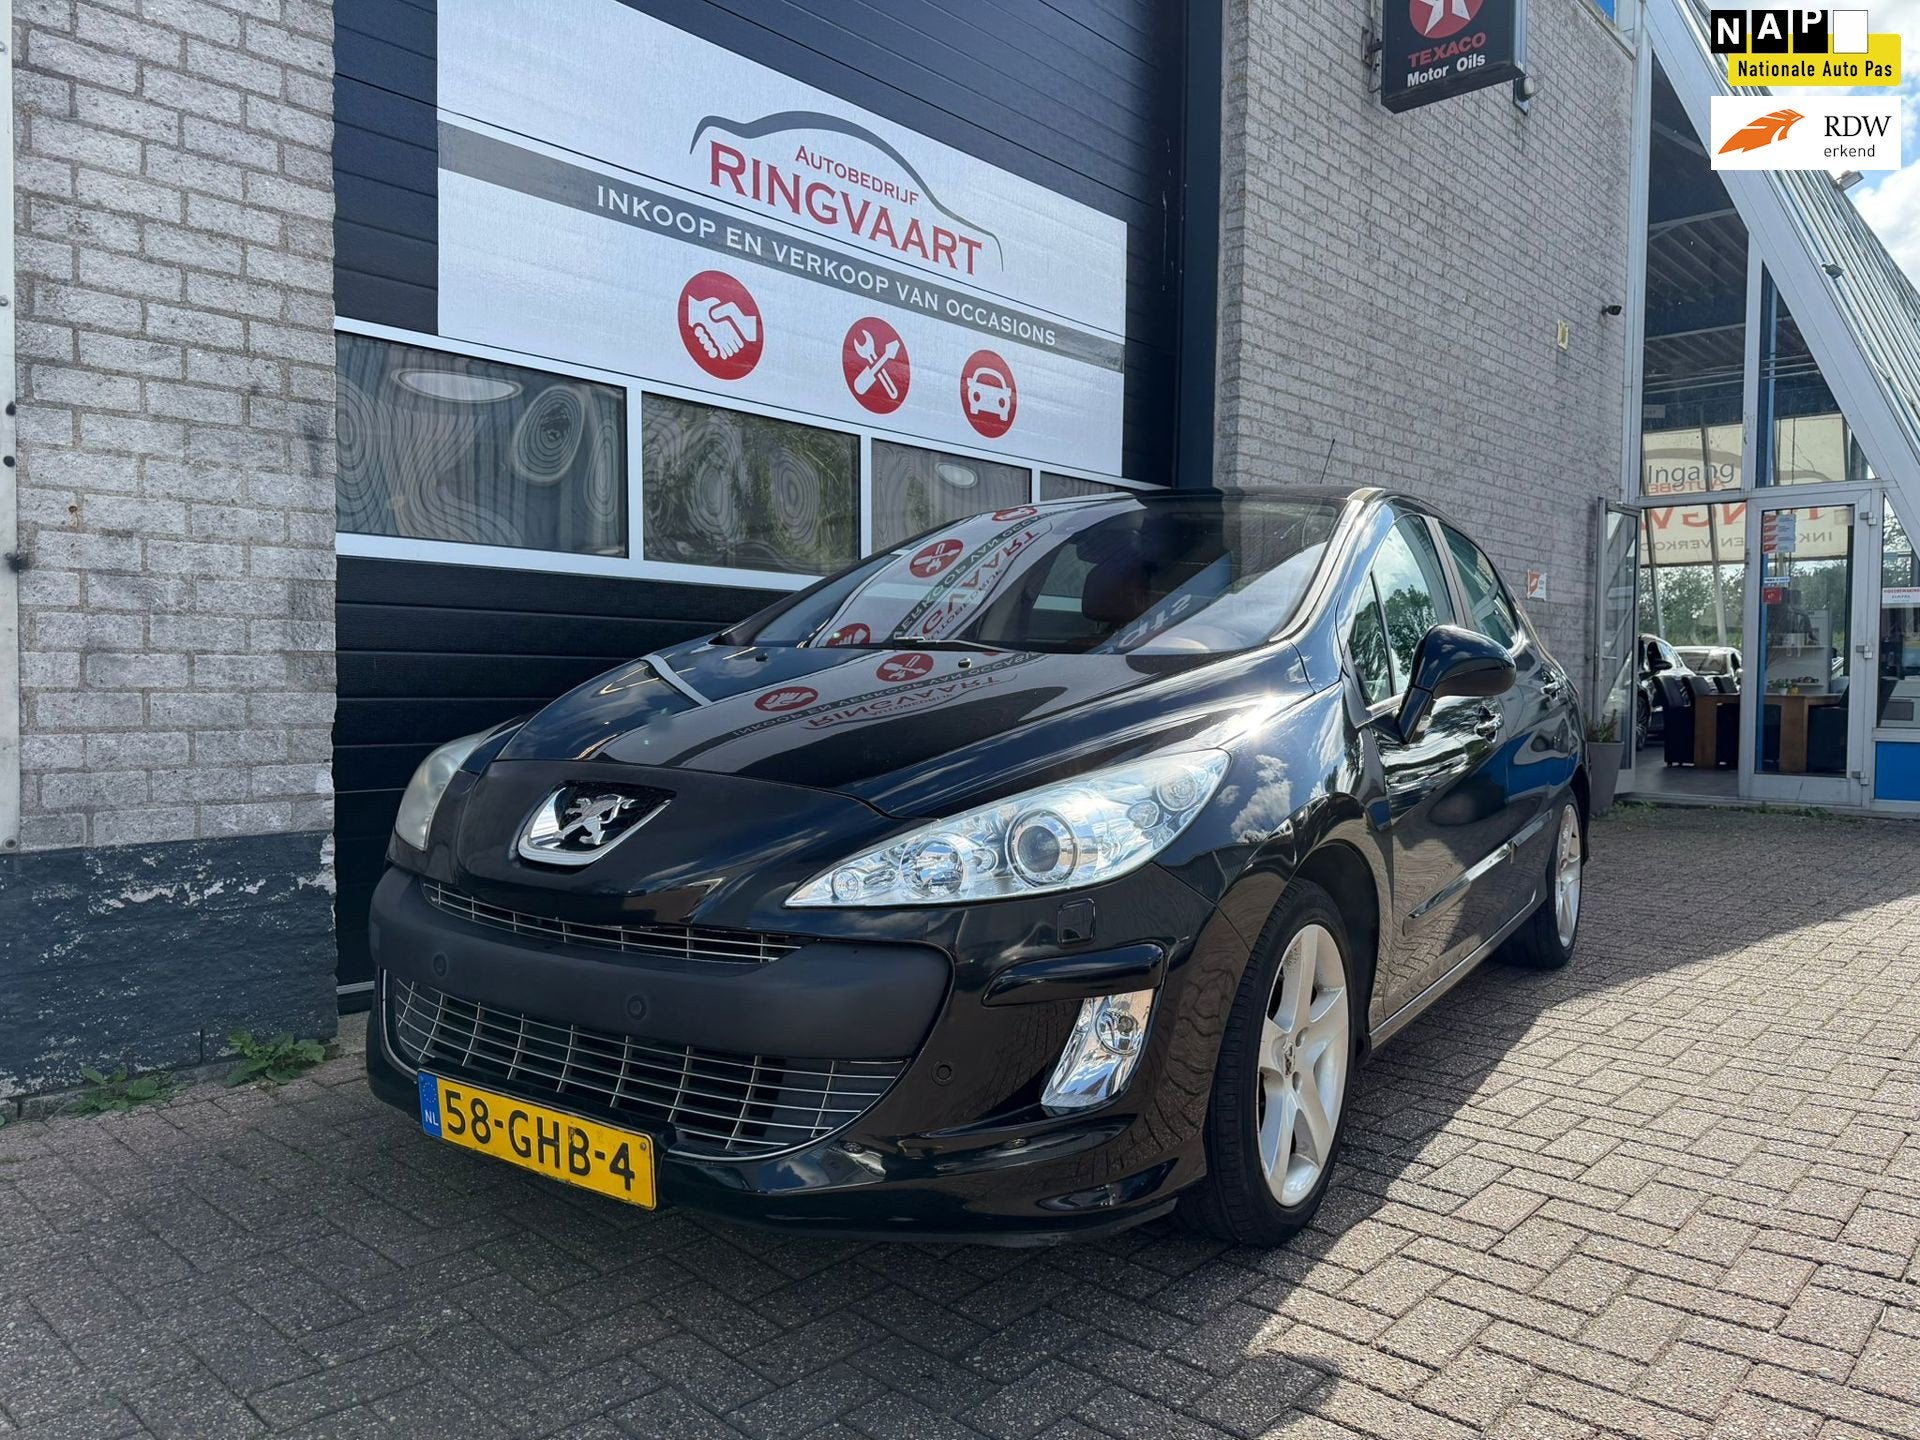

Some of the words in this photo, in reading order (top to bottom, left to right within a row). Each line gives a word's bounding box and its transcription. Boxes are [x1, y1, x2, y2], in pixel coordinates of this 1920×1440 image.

[1407, 65, 1449, 88] Motor
[1456, 53, 1486, 72] Oils
[1408, 32, 1487, 68] TEXACO
[795, 145, 919, 206] AUTOBEDRIJF
[709, 140, 983, 276] RINGVAART
[597, 185, 717, 240] INKOOP
[726, 226, 762, 256] EN
[772, 238, 889, 294] VERKOOP
[895, 281, 939, 312] VAN
[945, 296, 1056, 347] OCCASIONS
[1648, 463, 1735, 487] Ingang
[424, 1108, 440, 1127] NL
[444, 1088, 636, 1192] 58-GHB-4
